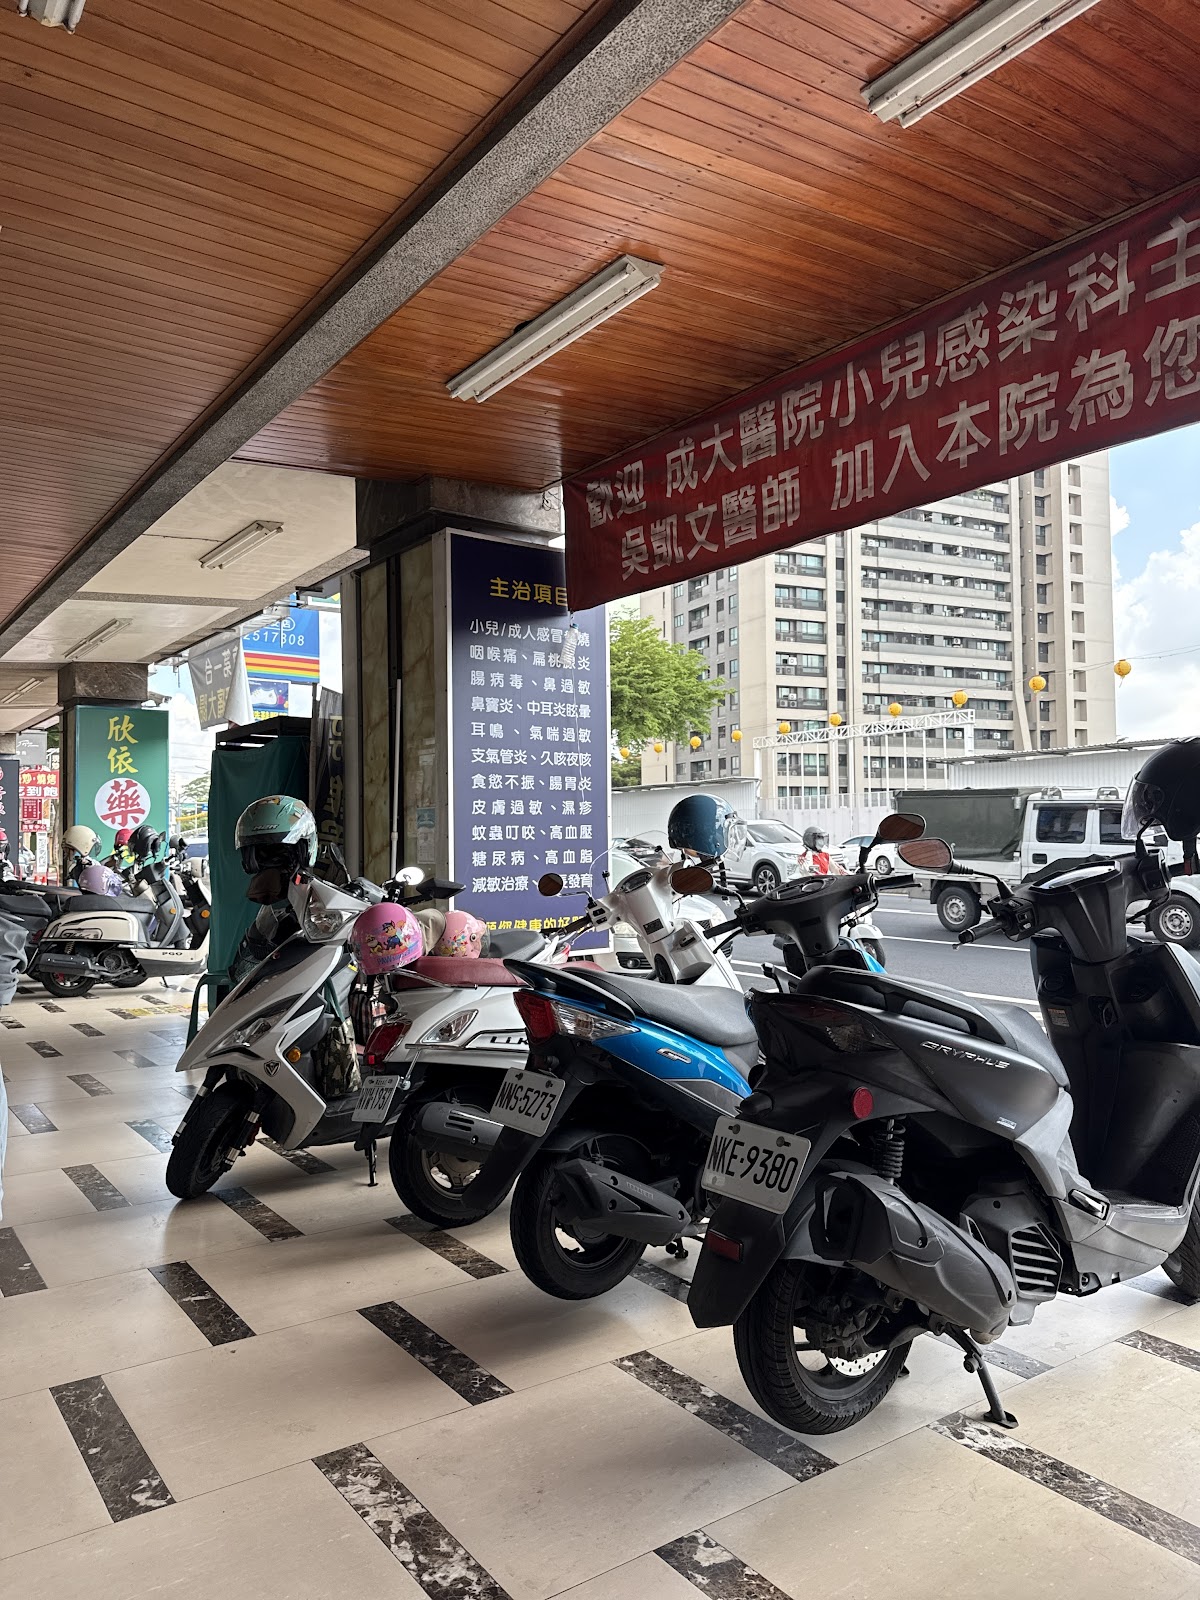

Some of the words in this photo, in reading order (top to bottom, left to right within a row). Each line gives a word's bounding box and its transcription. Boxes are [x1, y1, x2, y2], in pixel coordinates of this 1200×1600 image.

[620, 466, 801, 582] 吳凱文醫師
[830, 318, 1200, 512] 加入本院為您
[585, 459, 647, 529] 歡迎
[470, 618, 590, 647] 小兒/成人感冒燒
[472, 873, 593, 893] 減敏治療、發育
[707, 1135, 799, 1193] NKE-9380
